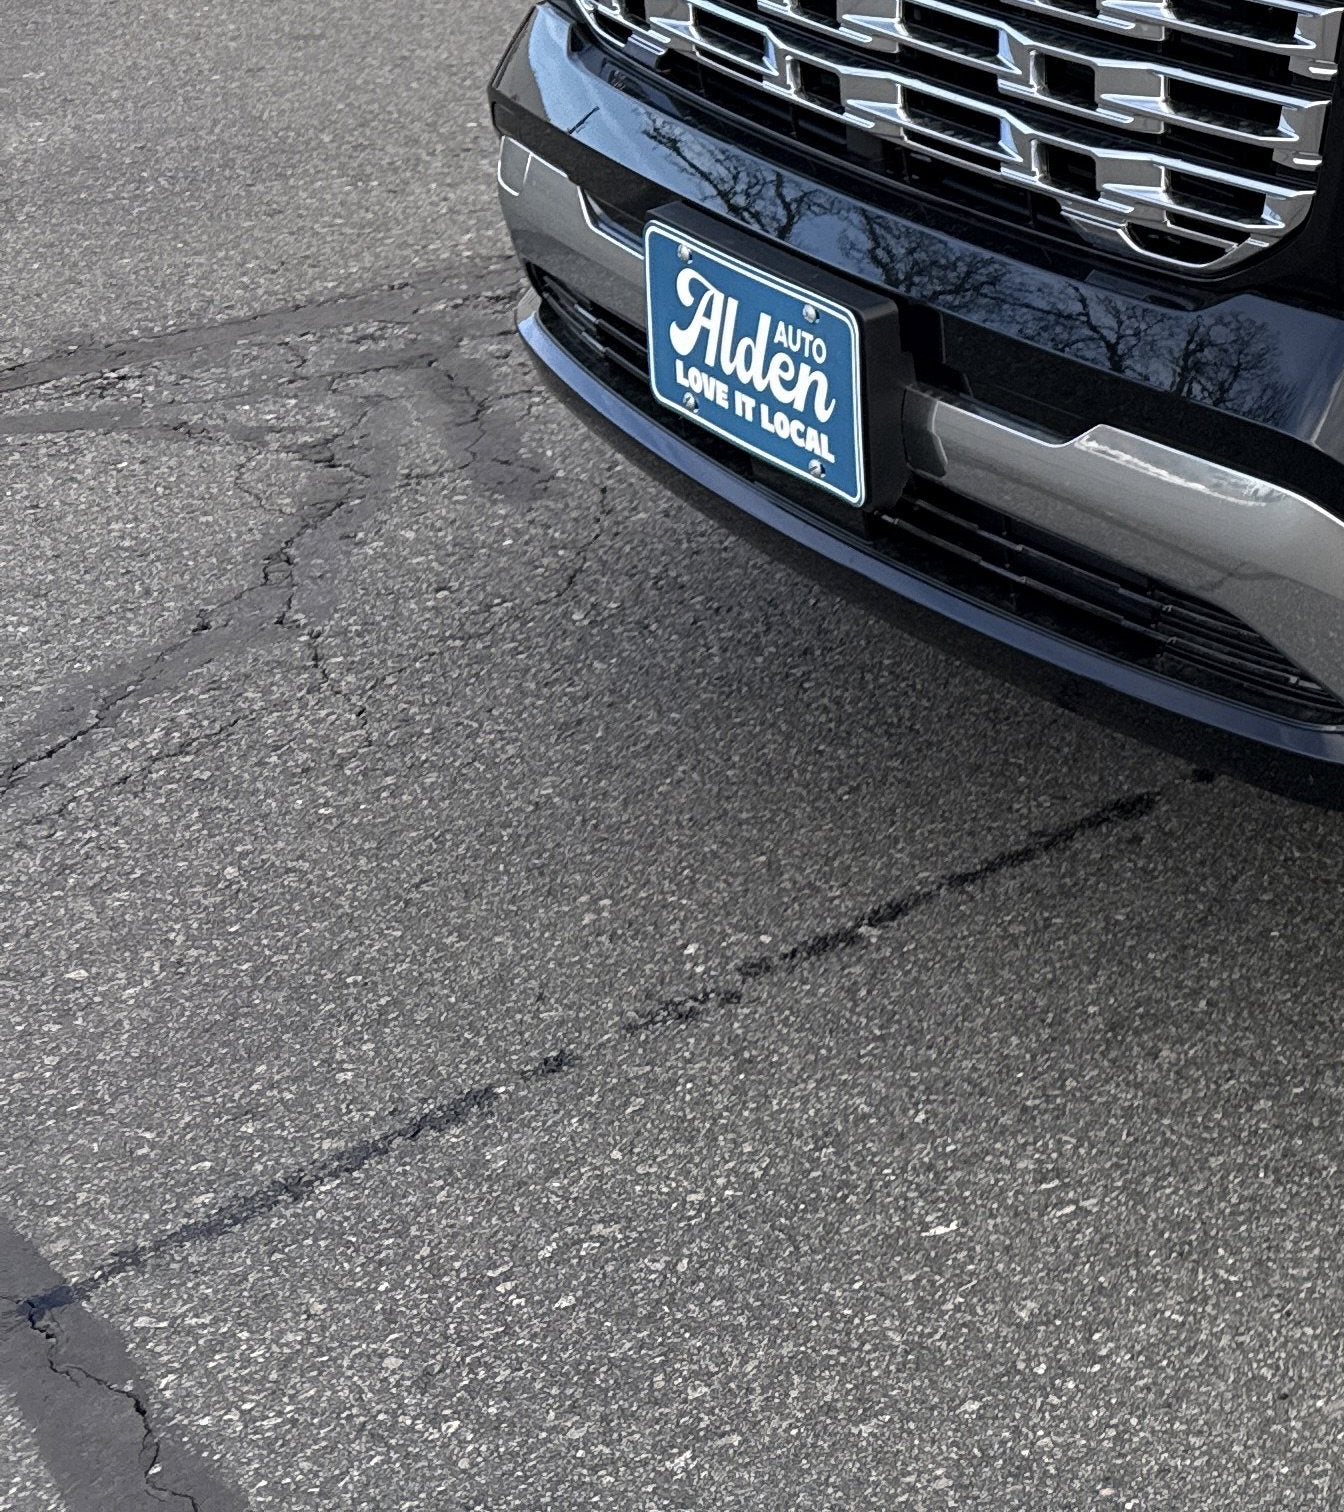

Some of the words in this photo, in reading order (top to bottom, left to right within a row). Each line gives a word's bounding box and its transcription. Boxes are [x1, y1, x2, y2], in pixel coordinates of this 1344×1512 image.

[669, 267, 836, 423] Alden
[773, 320, 828, 364] AUTO
[675, 359, 730, 410] LOVE
[734, 389, 756, 423] IT
[760, 403, 836, 464] LOCAL
